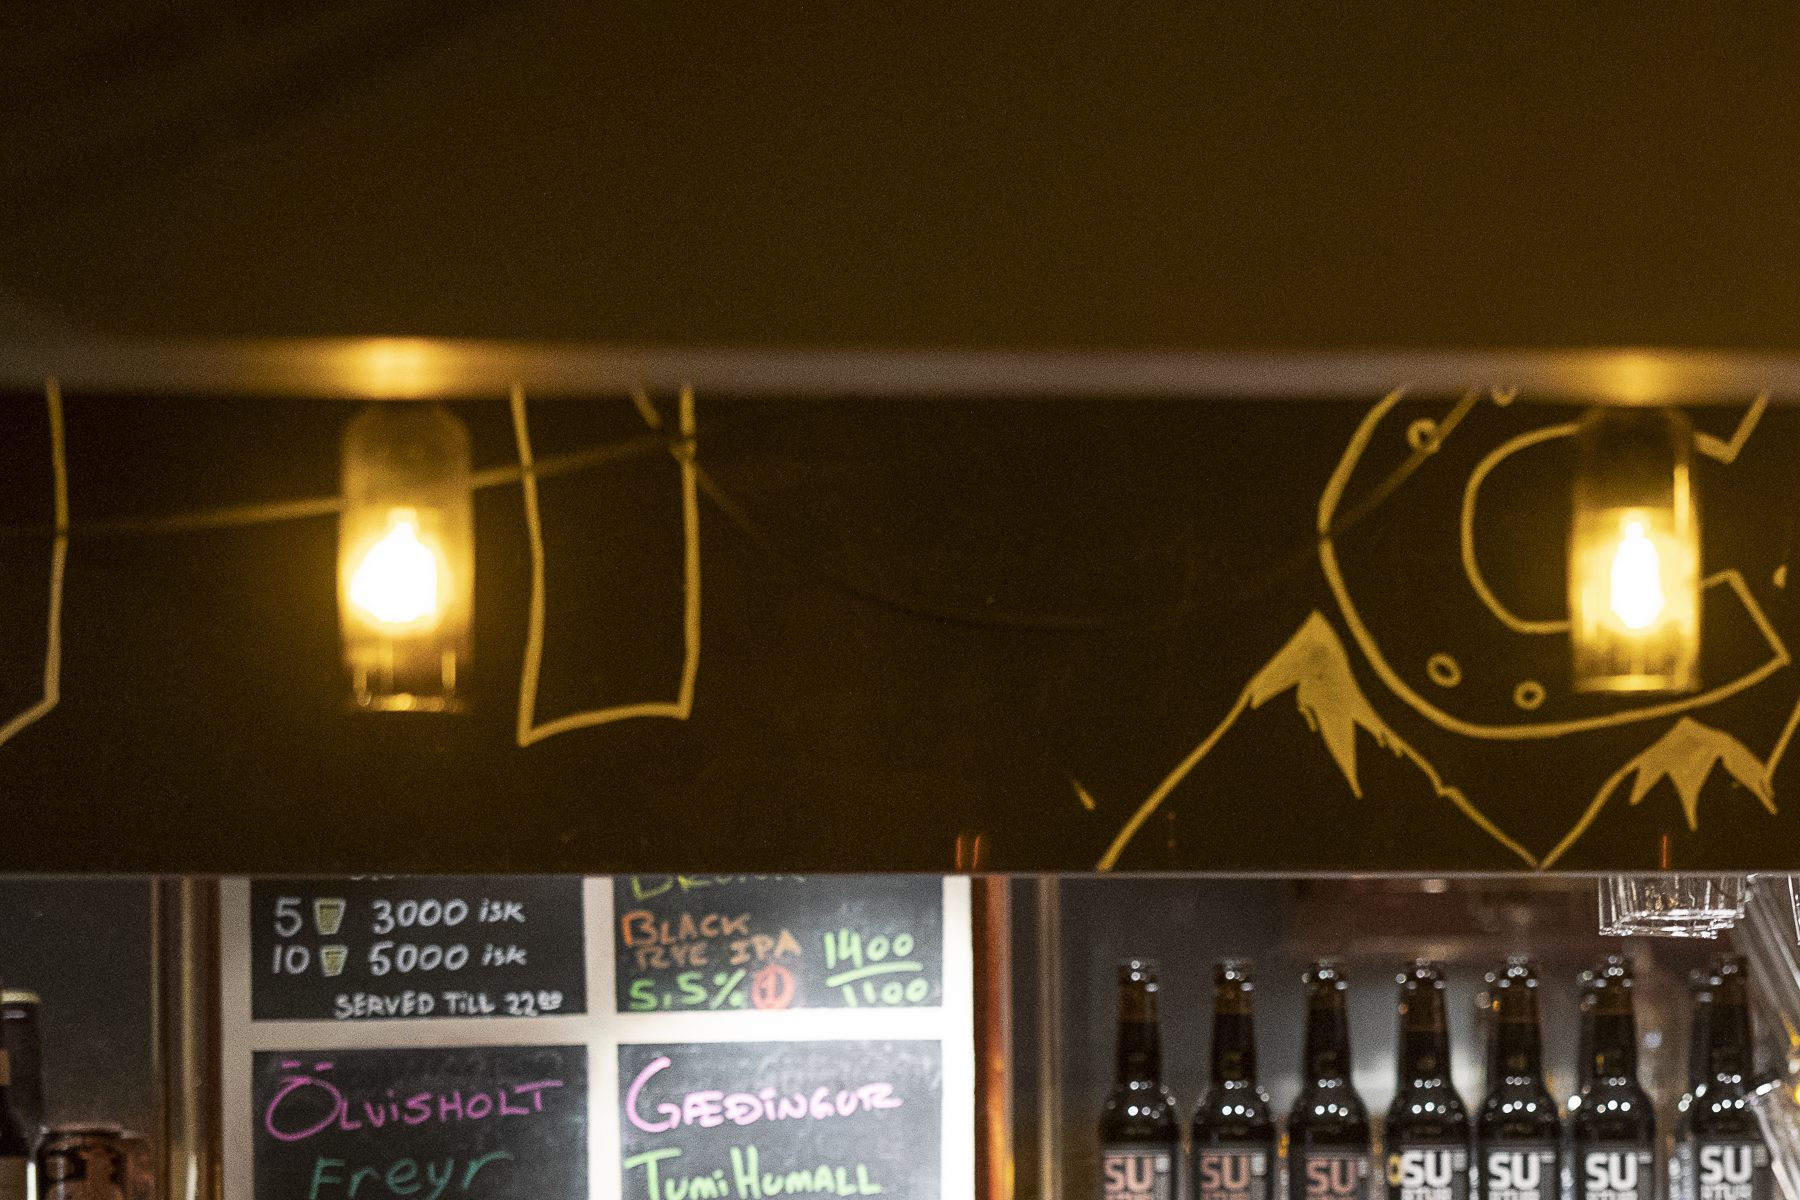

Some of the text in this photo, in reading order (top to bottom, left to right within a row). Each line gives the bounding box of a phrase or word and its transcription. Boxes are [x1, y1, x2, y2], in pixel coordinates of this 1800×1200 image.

[274, 897, 526, 937] 5 3000 isk
[622, 909, 750, 948] BLACK
[272, 940, 527, 977] 10 5000 isk
[730, 929, 801, 966] IPA
[823, 928, 915, 969] 1400
[335, 993, 435, 1020] SERVED
[842, 977, 929, 1008] 1100
[1104, 1156, 1153, 1192] SU
[1201, 1156, 1250, 1191] SU
[1307, 1160, 1355, 1195] SU
[1402, 1149, 1451, 1187] SU
[1489, 1152, 1540, 1191] SU
[1586, 1152, 1637, 1191] SU
[1700, 1145, 1752, 1183] SU
